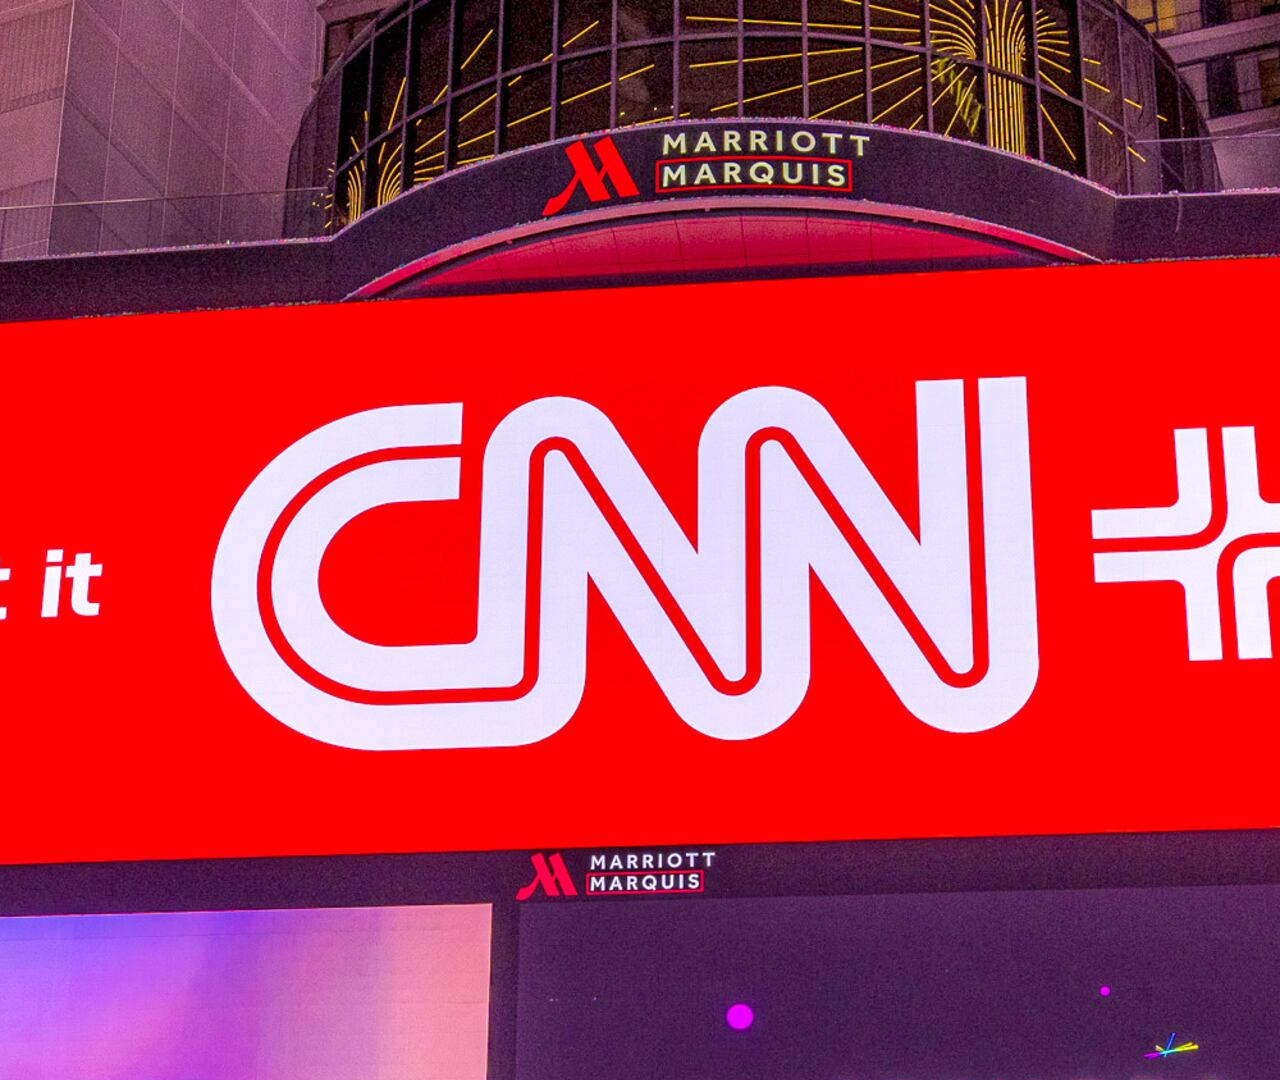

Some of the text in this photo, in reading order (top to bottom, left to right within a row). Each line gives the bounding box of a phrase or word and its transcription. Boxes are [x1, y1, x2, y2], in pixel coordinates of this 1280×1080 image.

[661, 129, 871, 158] MARRIOTT
[661, 162, 847, 188] MARQUIS
[42, 550, 103, 617] it
[590, 852, 716, 871] MARRIOTT
[590, 874, 700, 892] MARQUIS
